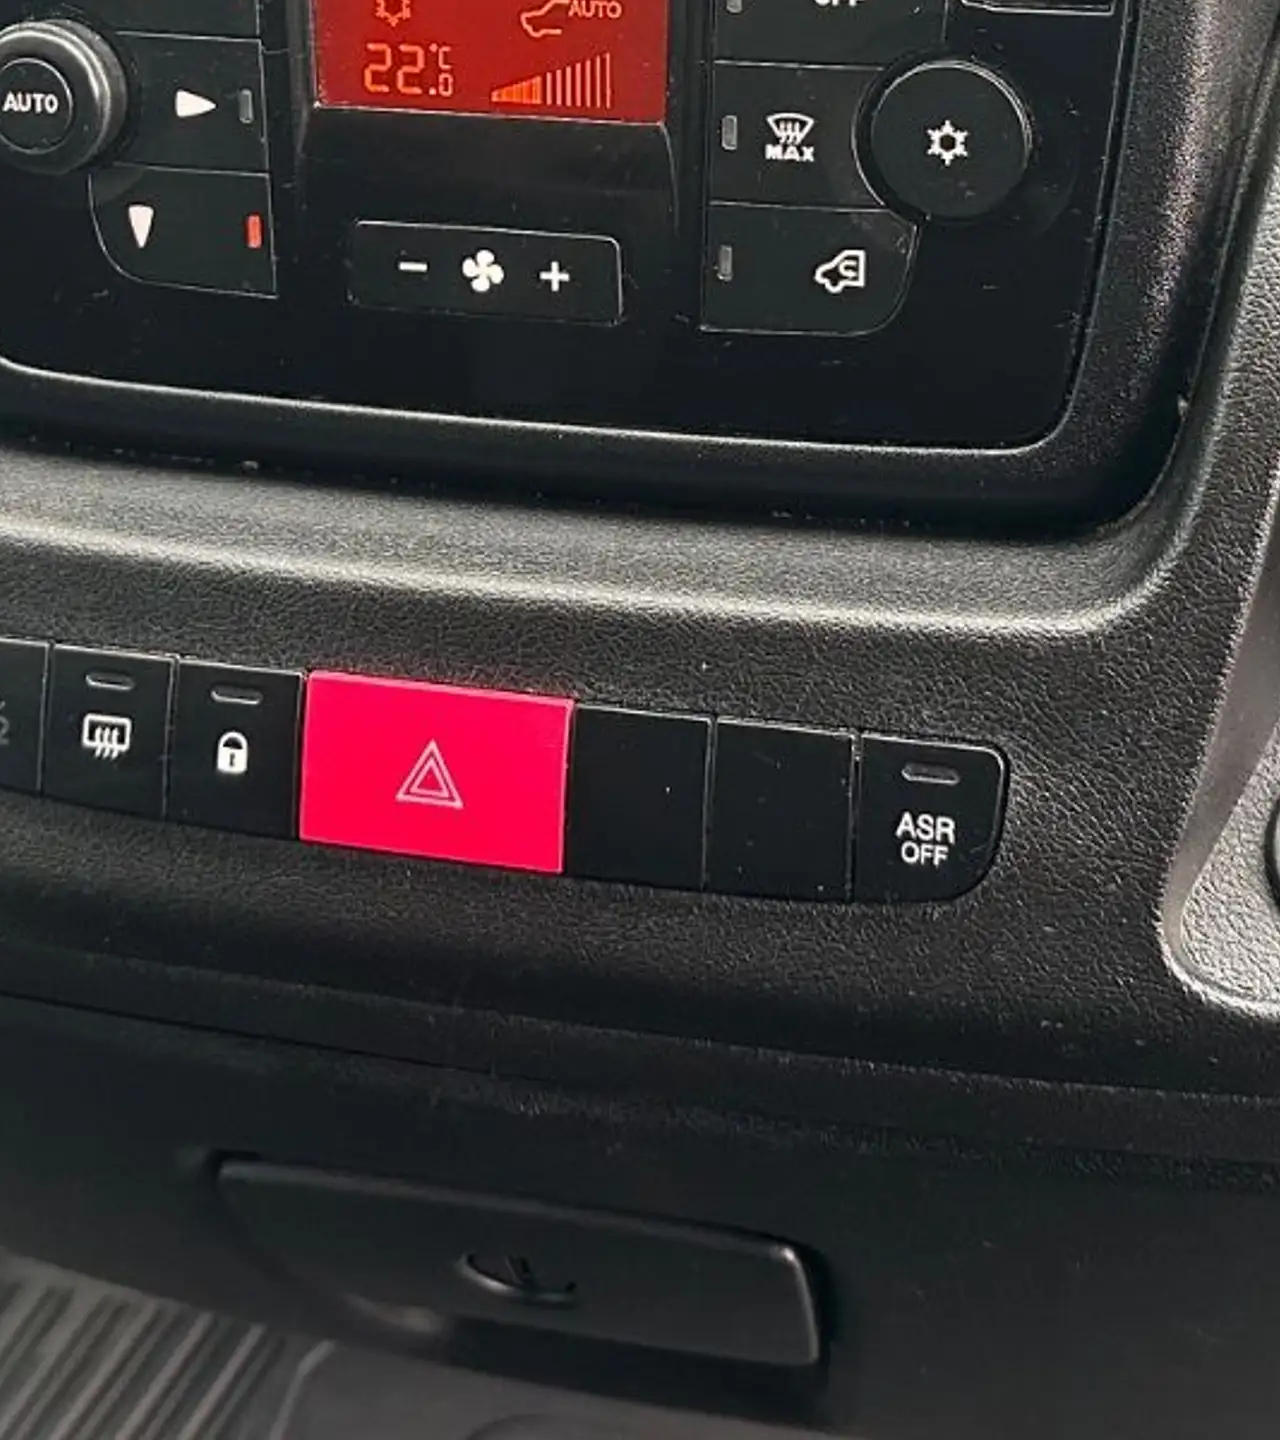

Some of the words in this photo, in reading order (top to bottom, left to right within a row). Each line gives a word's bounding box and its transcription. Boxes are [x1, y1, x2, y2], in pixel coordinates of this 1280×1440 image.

[2, 91, 59, 114] AUTO
[764, 144, 815, 163] MAX
[895, 811, 956, 845] ASR
[901, 842, 949, 866] OFF
